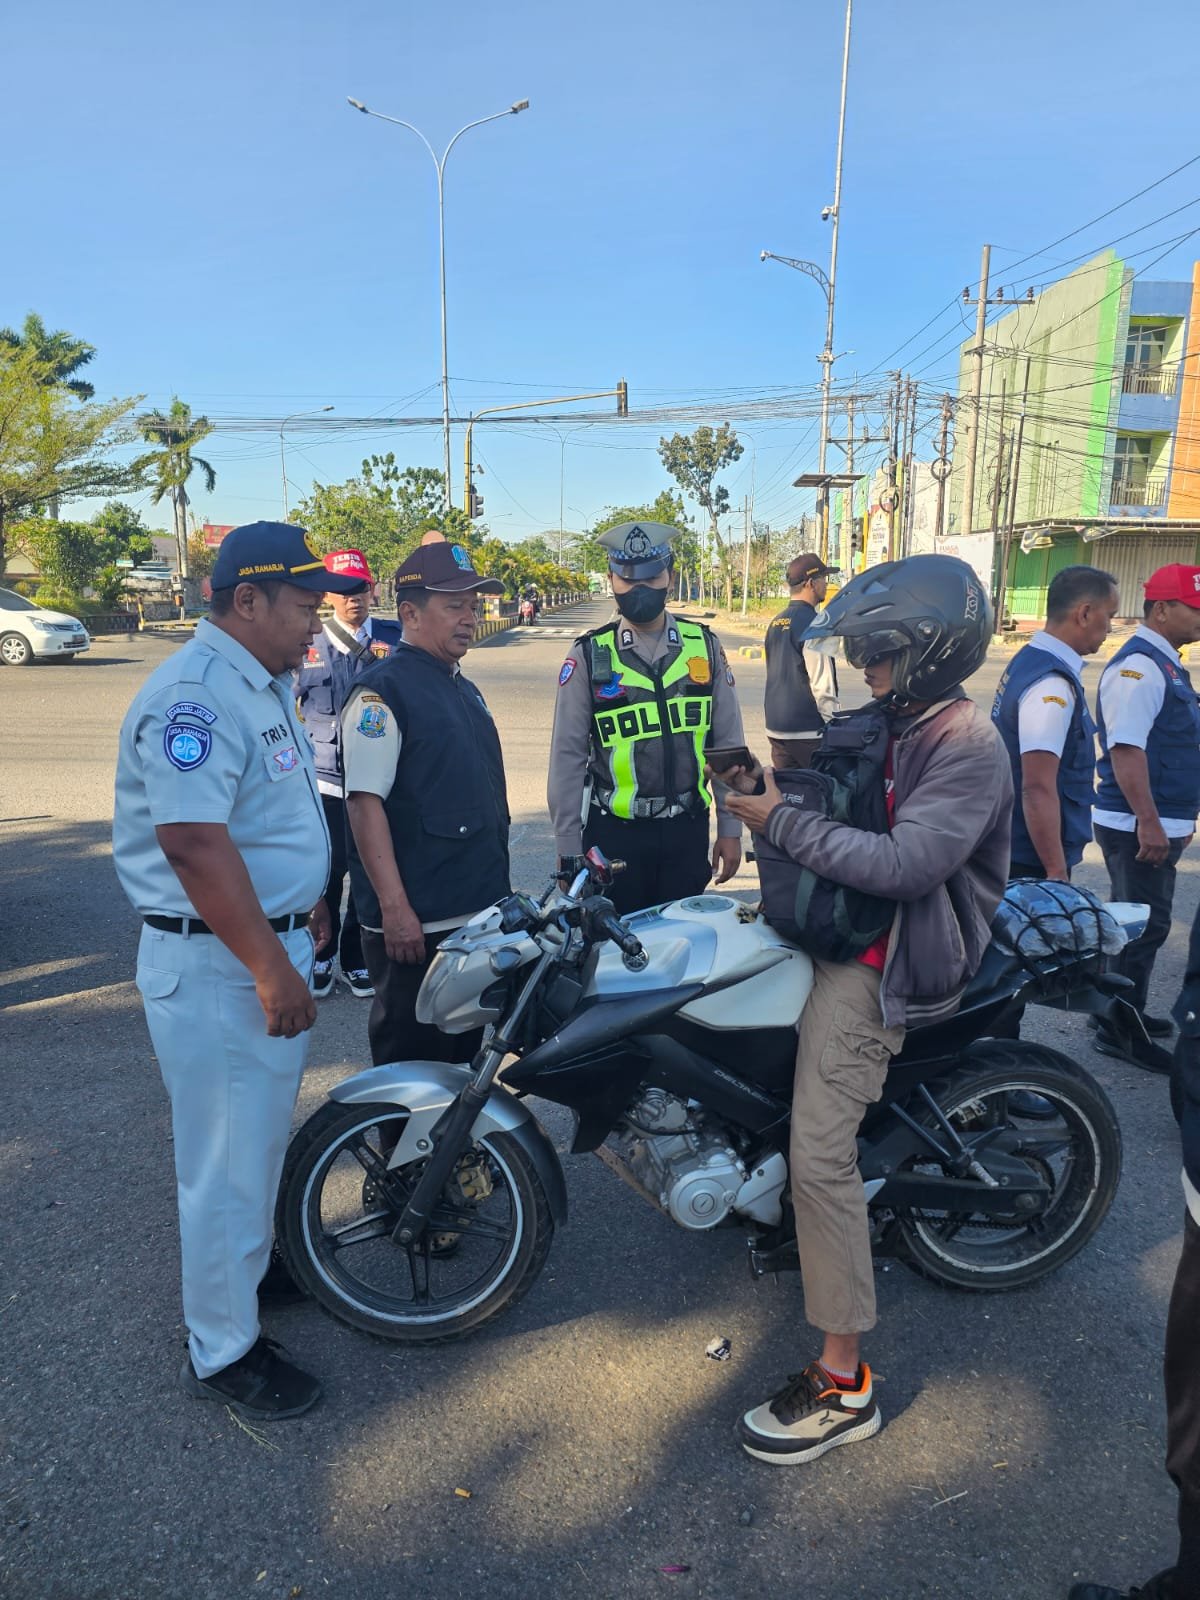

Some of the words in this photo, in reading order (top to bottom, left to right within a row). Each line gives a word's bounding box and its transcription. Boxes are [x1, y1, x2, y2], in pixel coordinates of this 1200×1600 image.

[238, 567, 254, 577] JASA
[255, 563, 285, 574] RAHARJA
[598, 700, 711, 743] POLISI
